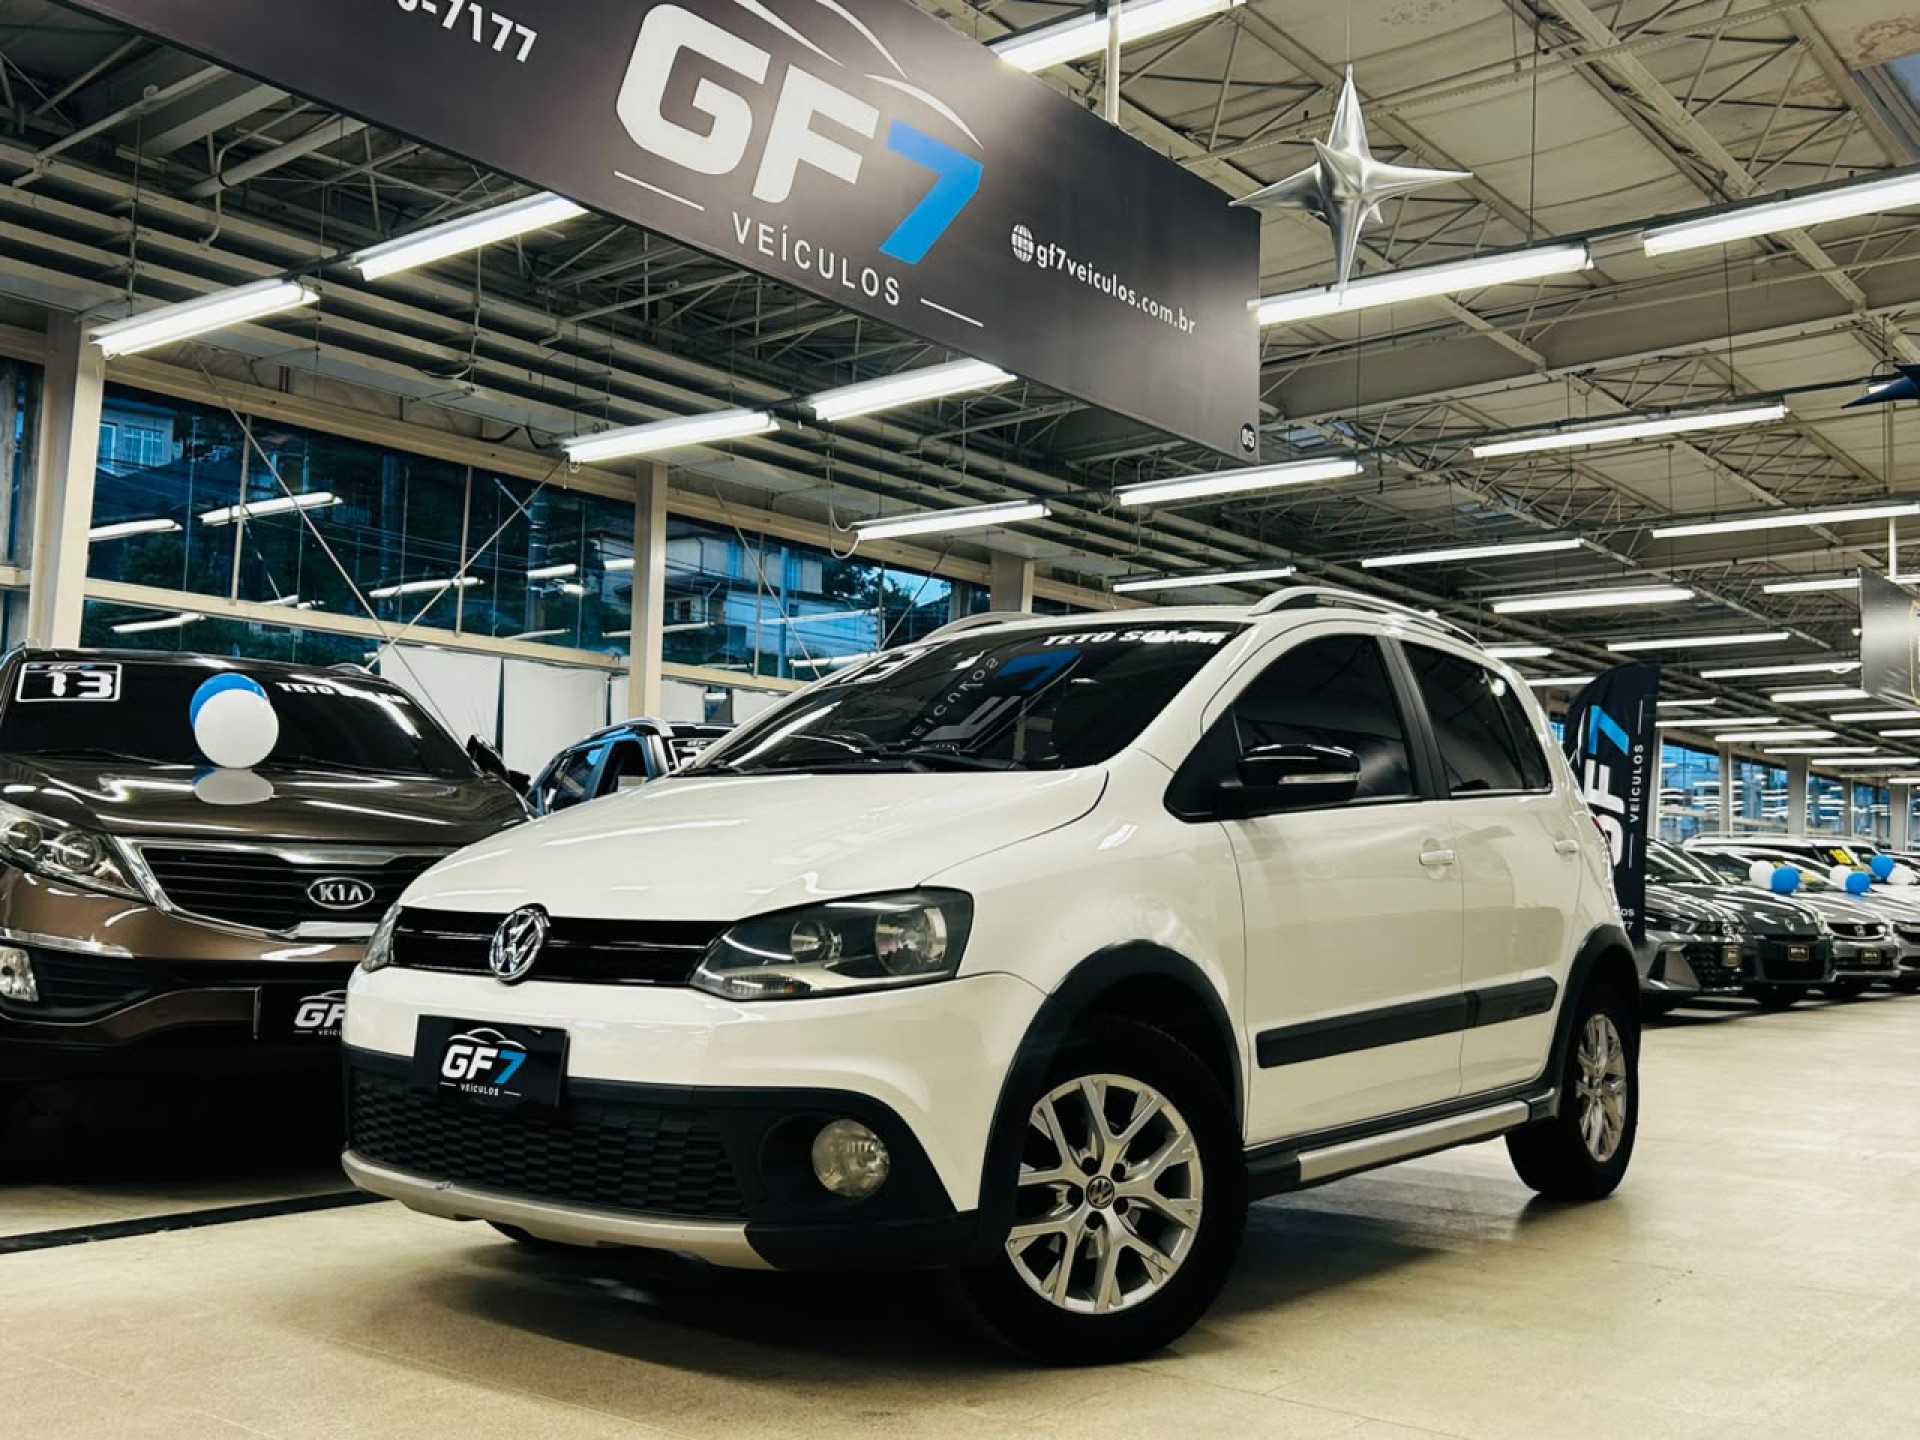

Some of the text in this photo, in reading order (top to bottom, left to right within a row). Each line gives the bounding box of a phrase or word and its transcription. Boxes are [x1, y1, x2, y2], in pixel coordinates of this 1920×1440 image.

[397, 0, 538, 63] -7177
[615, 3, 984, 265] GF7
[732, 211, 900, 306] VEÍCULOS
[1036, 242, 1196, 334] gf7veiculos.com.br
[45, 671, 113, 698] 13
[319, 884, 364, 901] KIA
[294, 1002, 345, 1028] GF
[441, 1044, 527, 1085] GF7
